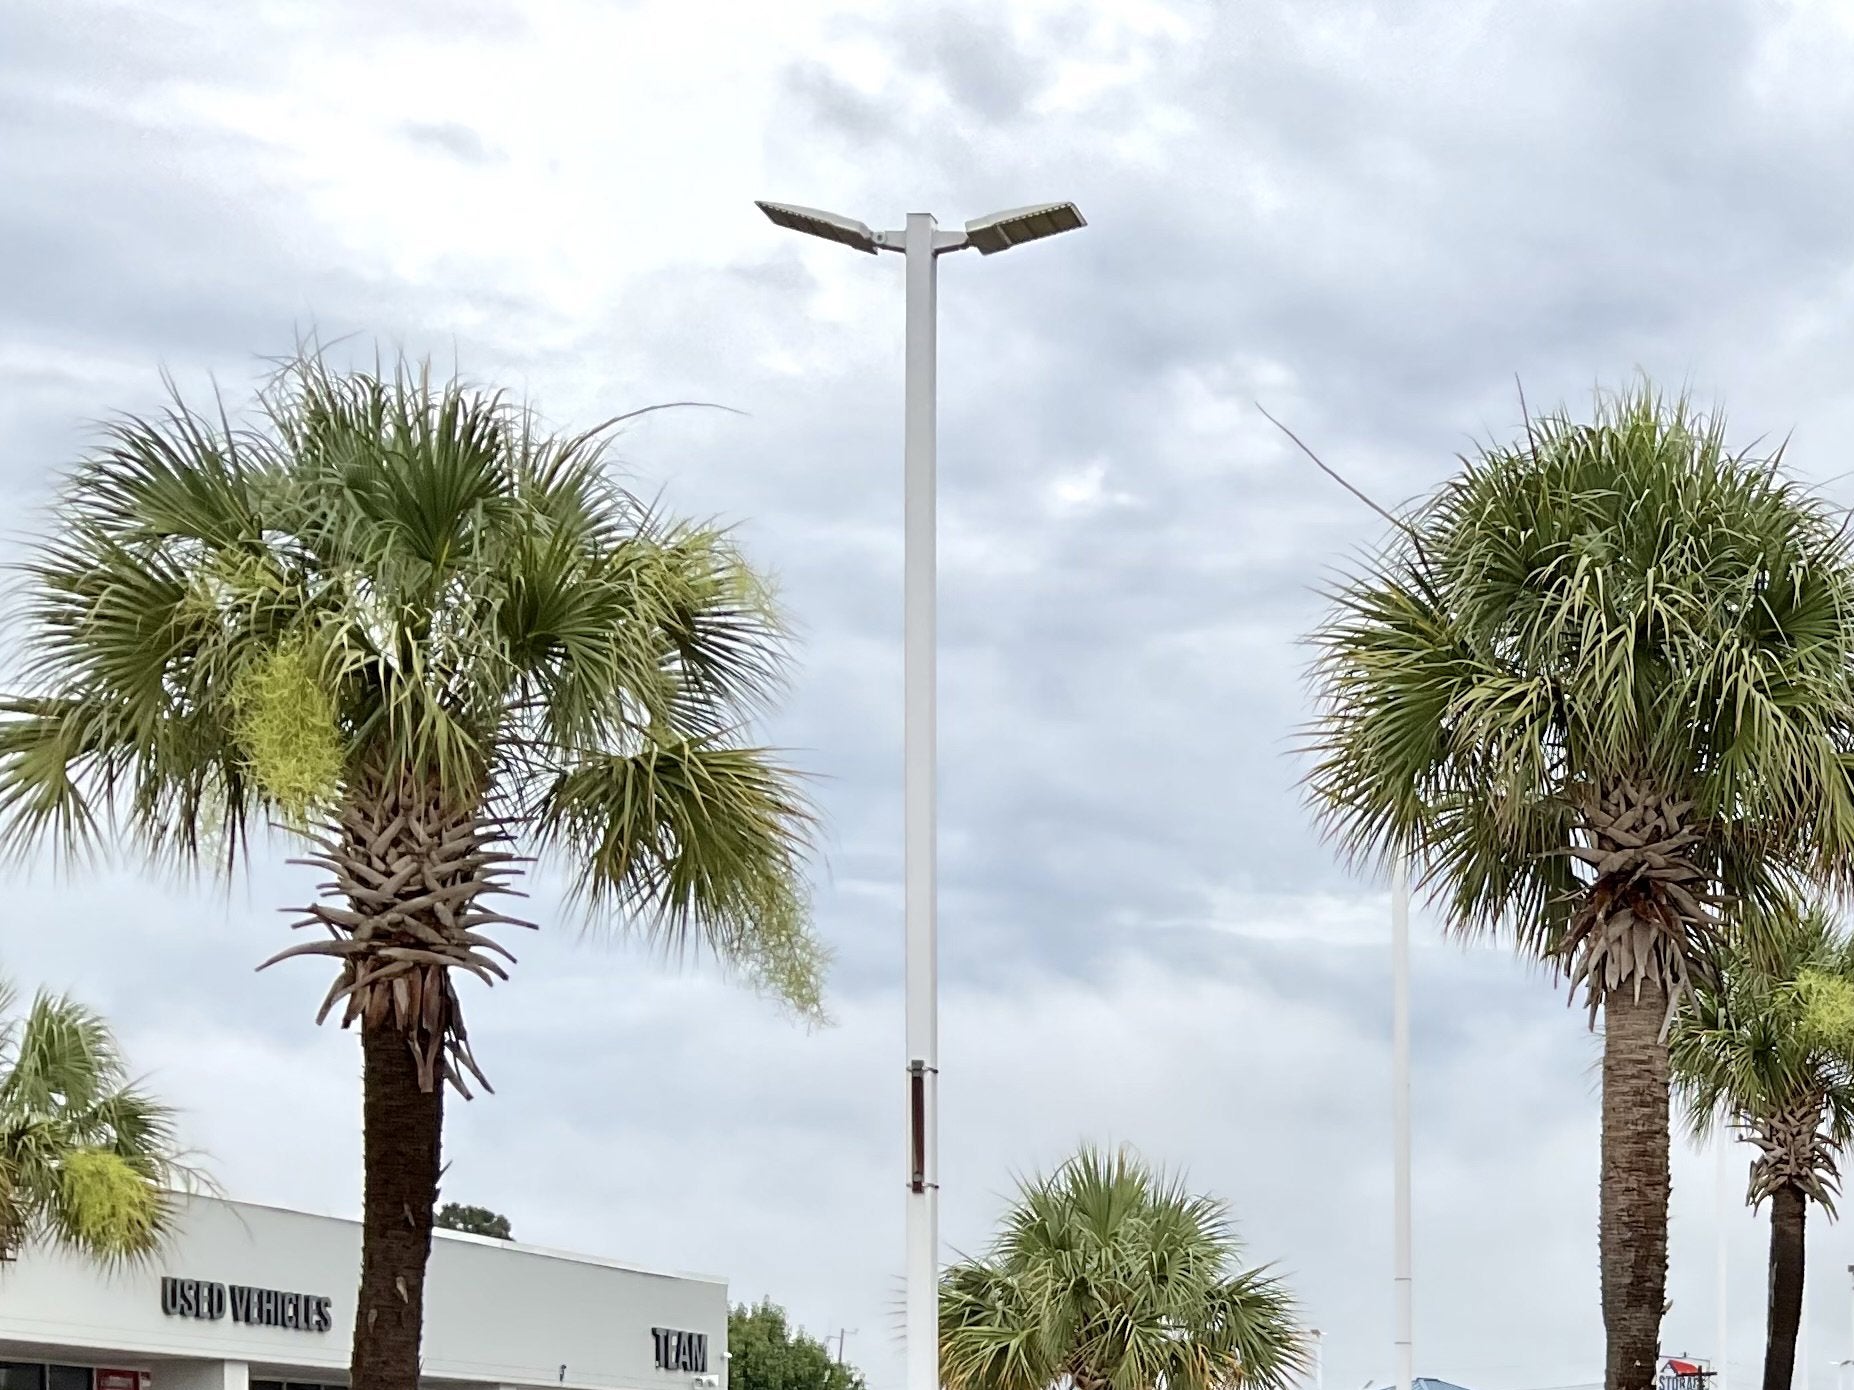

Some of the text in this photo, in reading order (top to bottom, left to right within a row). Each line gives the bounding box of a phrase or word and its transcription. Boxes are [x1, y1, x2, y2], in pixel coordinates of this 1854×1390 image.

[161, 1276, 333, 1333] USED VEHICLES
[651, 1327, 708, 1373] TEAM
